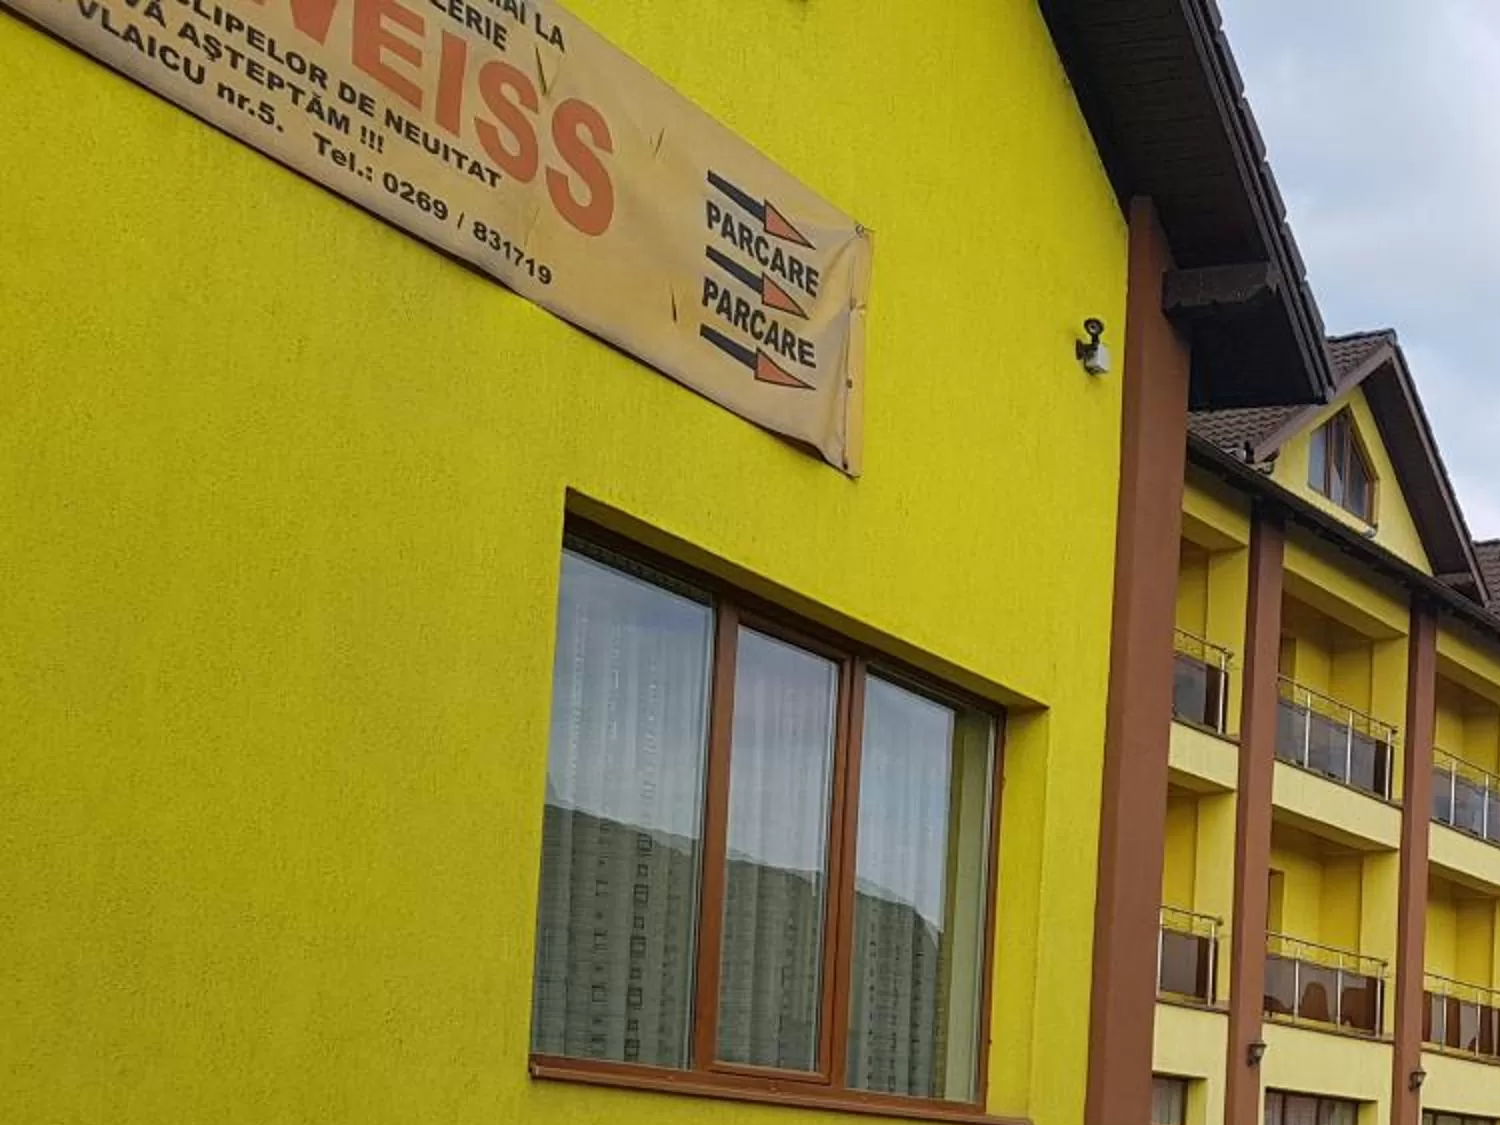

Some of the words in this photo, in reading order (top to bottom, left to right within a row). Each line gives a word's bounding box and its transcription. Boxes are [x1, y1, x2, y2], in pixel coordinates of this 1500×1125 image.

[488, 0, 524, 25] AI
[534, 12, 566, 53] LA
[77, 0, 206, 85] VLAICU
[312, 131, 373, 182] Tel.:
[382, 171, 449, 221] 0269
[472, 221, 553, 285] 831719
[178, 0, 328, 90] LIPELOR
[337, 79, 376, 118] DE
[384, 108, 503, 188] NEUITAT
[705, 199, 820, 298] PARCARE
[701, 275, 817, 369] PARCARE
